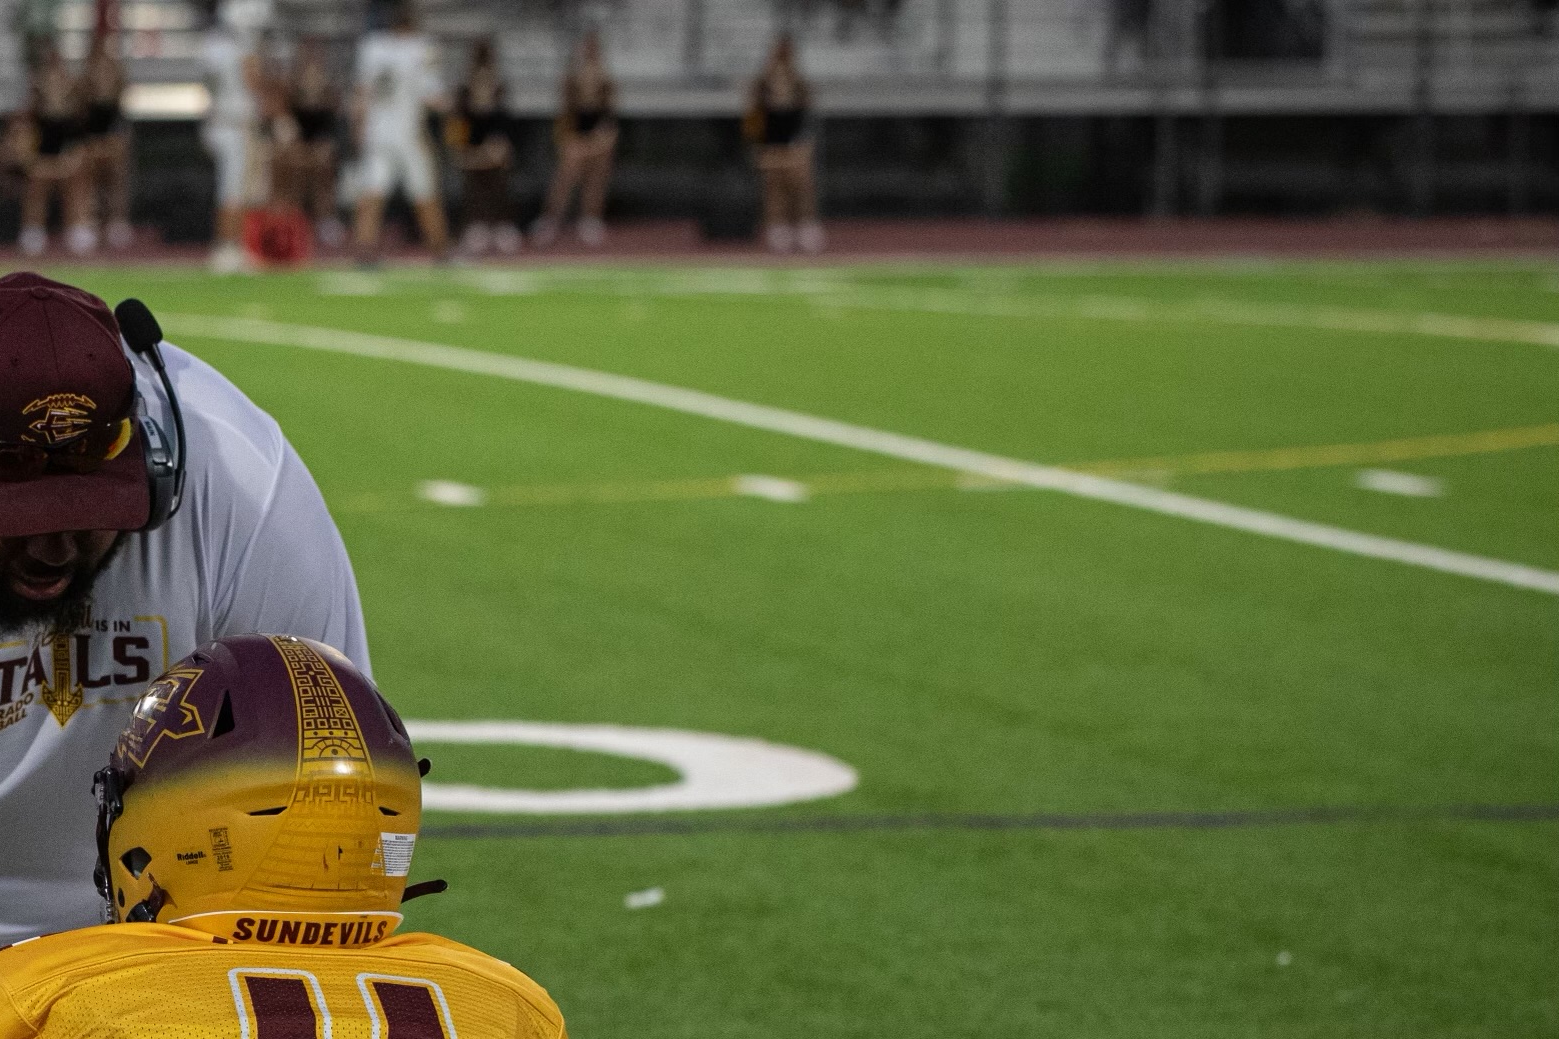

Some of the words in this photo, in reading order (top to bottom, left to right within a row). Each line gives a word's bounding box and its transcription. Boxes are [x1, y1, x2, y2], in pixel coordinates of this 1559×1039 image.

[95, 619, 109, 632] IS
[113, 619, 131, 632] IN
[232, 917, 388, 945] SUNDEVILS
